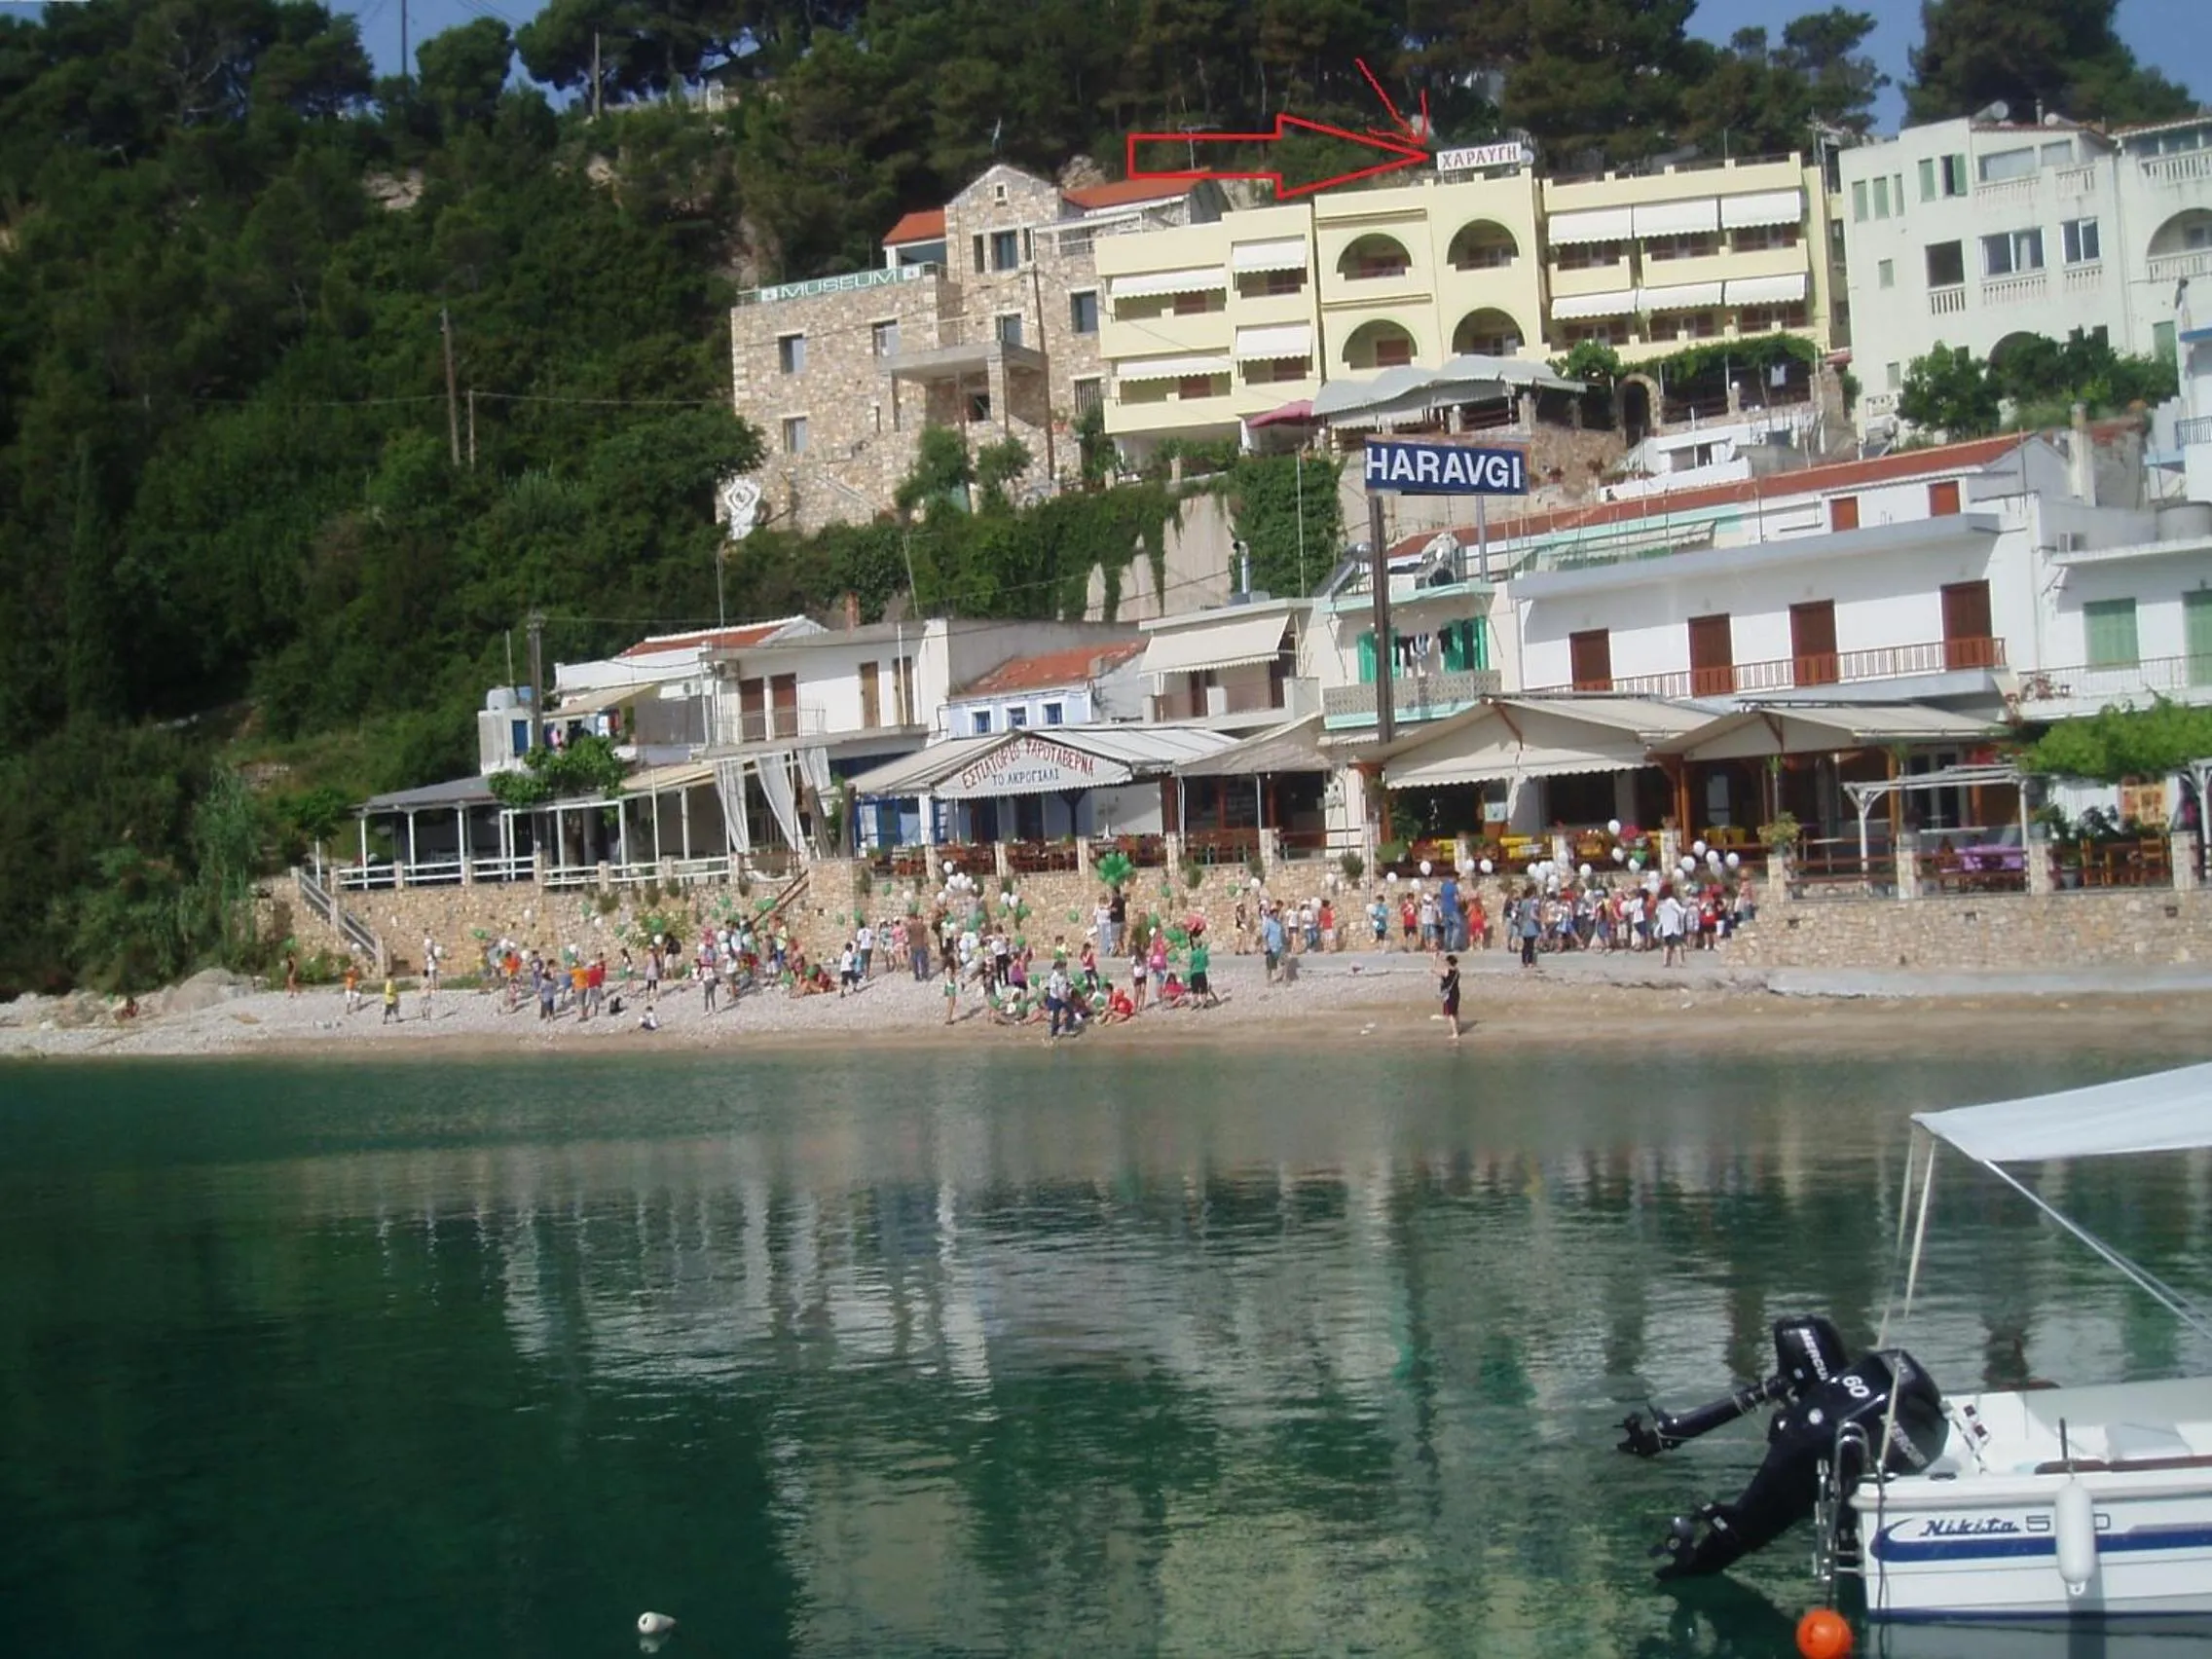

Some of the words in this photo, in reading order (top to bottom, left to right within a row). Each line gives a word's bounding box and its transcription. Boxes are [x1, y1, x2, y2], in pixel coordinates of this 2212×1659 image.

[1442, 145, 1517, 167] ΧΑΡΑΥΓΗ
[781, 269, 897, 298] MUSEUM
[1366, 448, 1520, 489] HARAVGI
[1842, 1375, 1870, 1398] 60
[1919, 1517, 2020, 1536] Nikita
[2026, 1513, 2111, 1532] 50
